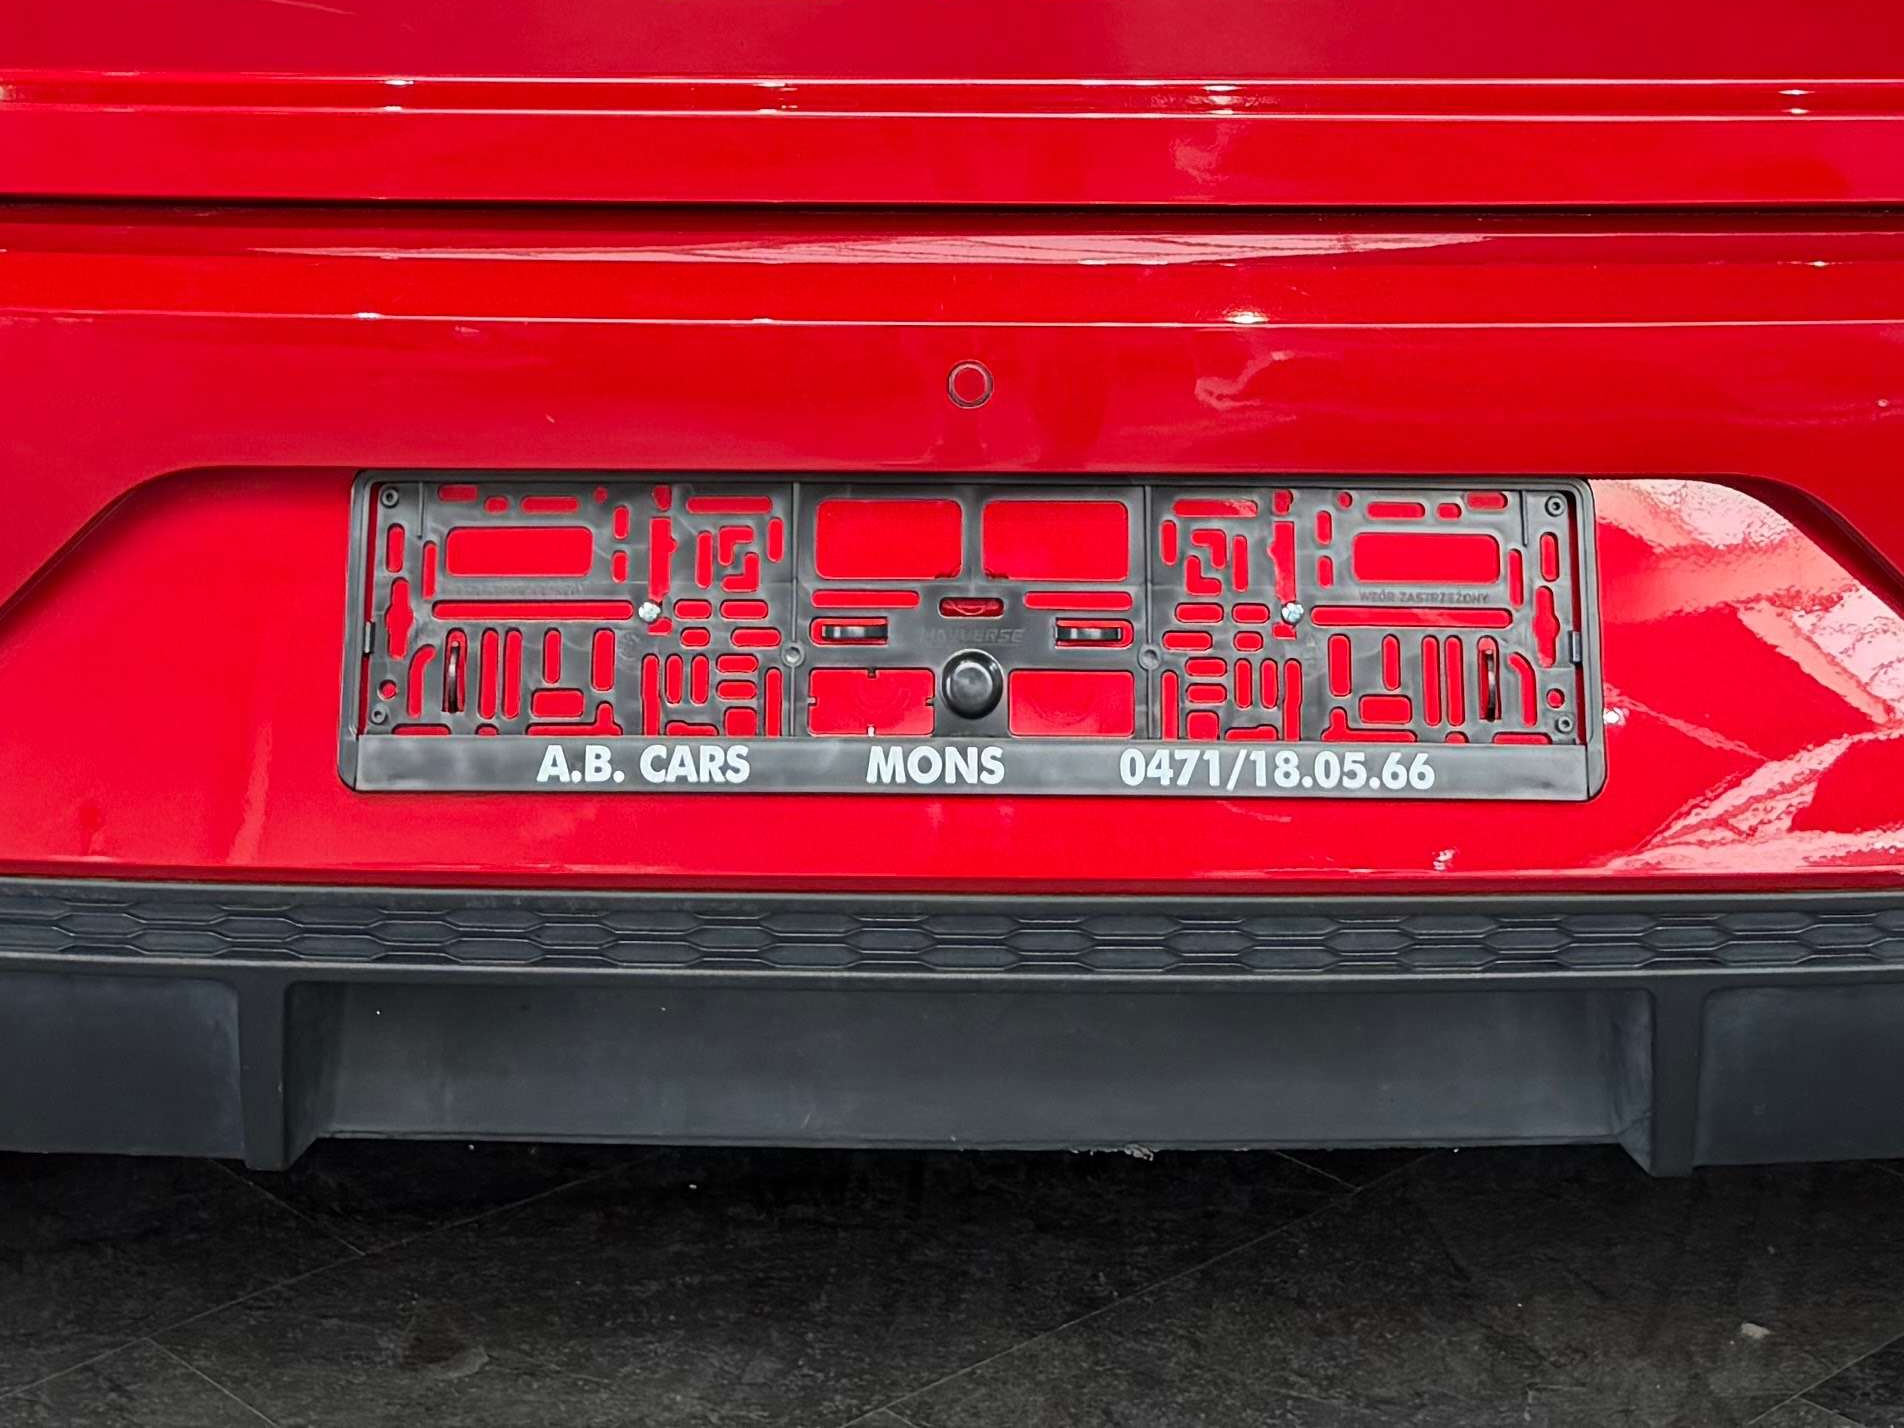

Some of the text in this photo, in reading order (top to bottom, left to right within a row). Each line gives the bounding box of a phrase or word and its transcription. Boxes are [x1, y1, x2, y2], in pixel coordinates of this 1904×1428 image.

[536, 744, 1436, 792] A.B. CARS MONS 0471/18.05.66
